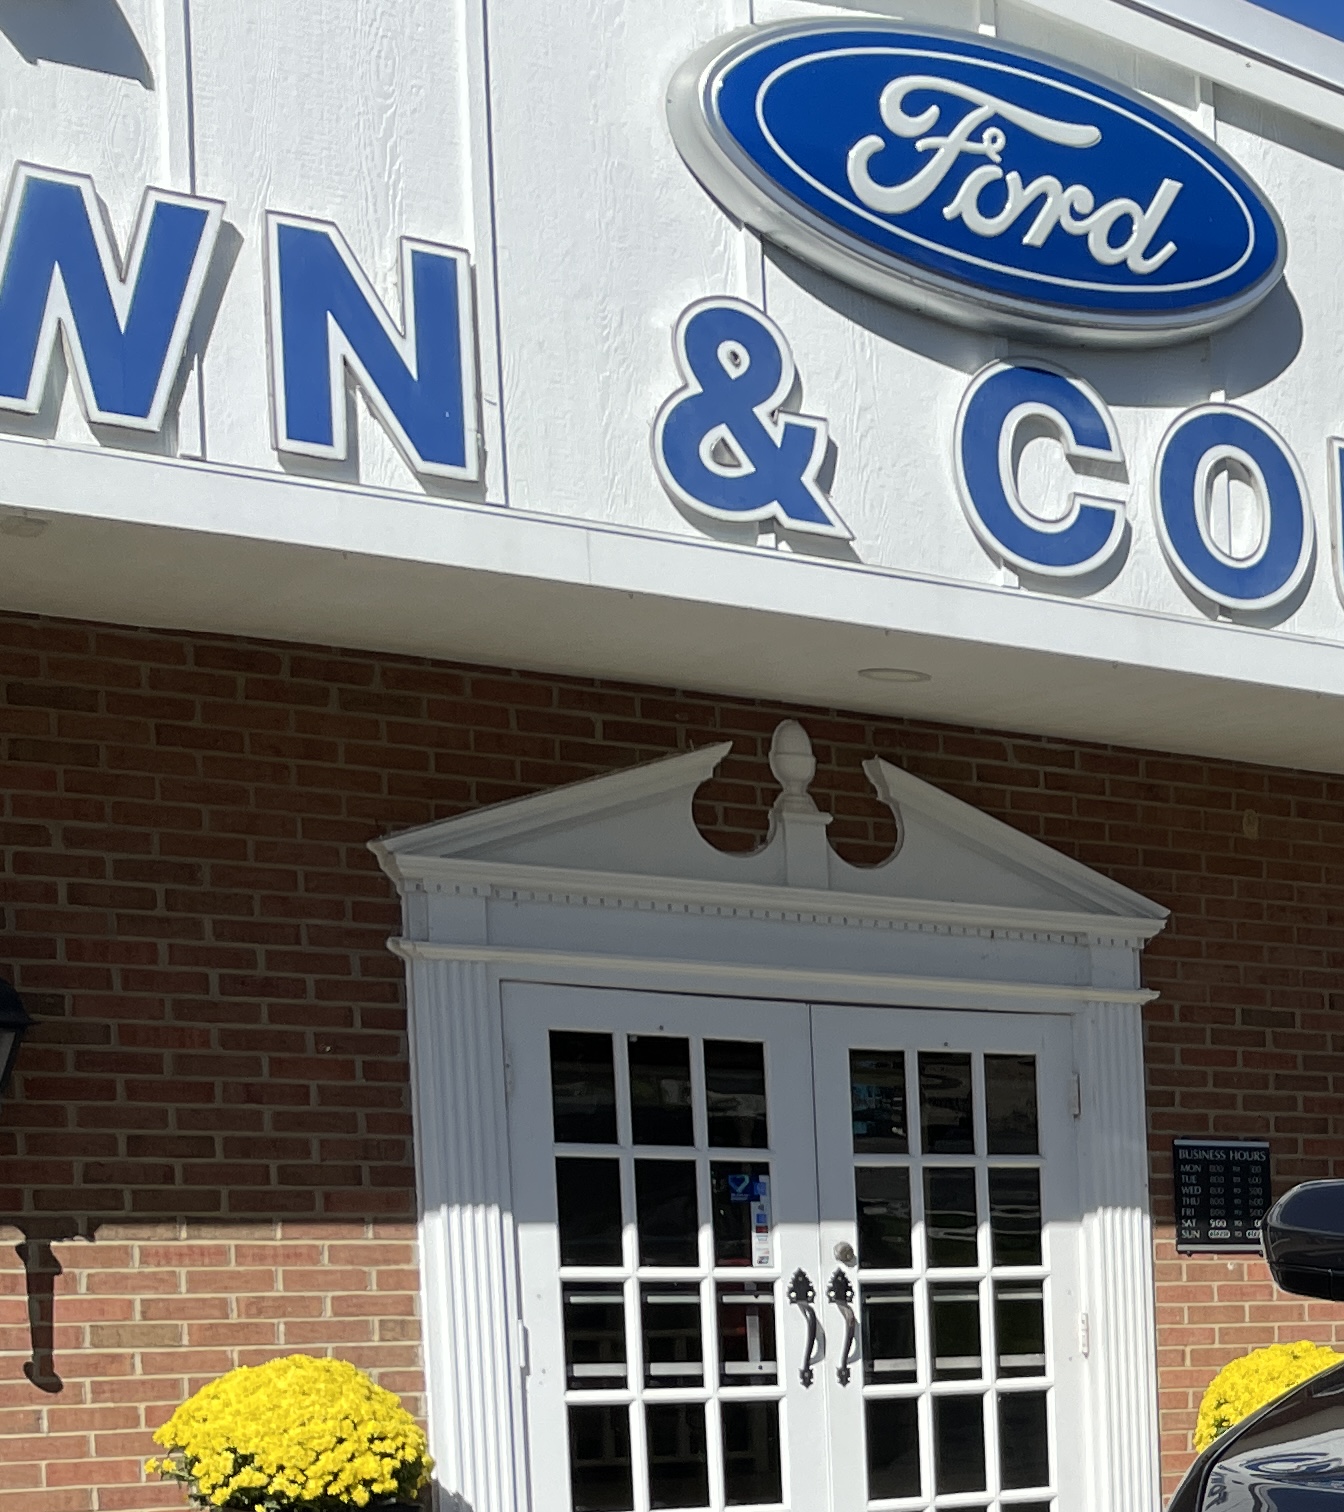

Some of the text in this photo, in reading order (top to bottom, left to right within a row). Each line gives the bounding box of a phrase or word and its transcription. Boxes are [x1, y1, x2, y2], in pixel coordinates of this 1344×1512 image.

[846, 76, 1183, 277] Ford
[650, 295, 854, 540] &
[1178, 1149, 1266, 1161] BUSINESS HOURS
[1180, 1164, 1202, 1173] MON
[1181, 1175, 1198, 1184] TUE
[1181, 1186, 1202, 1195] WED
[1182, 1197, 1200, 1206] THU
[1181, 1208, 1195, 1217] FRI
[1181, 1219, 1196, 1228] SAT
[1181, 1230, 1200, 1239] SUN
